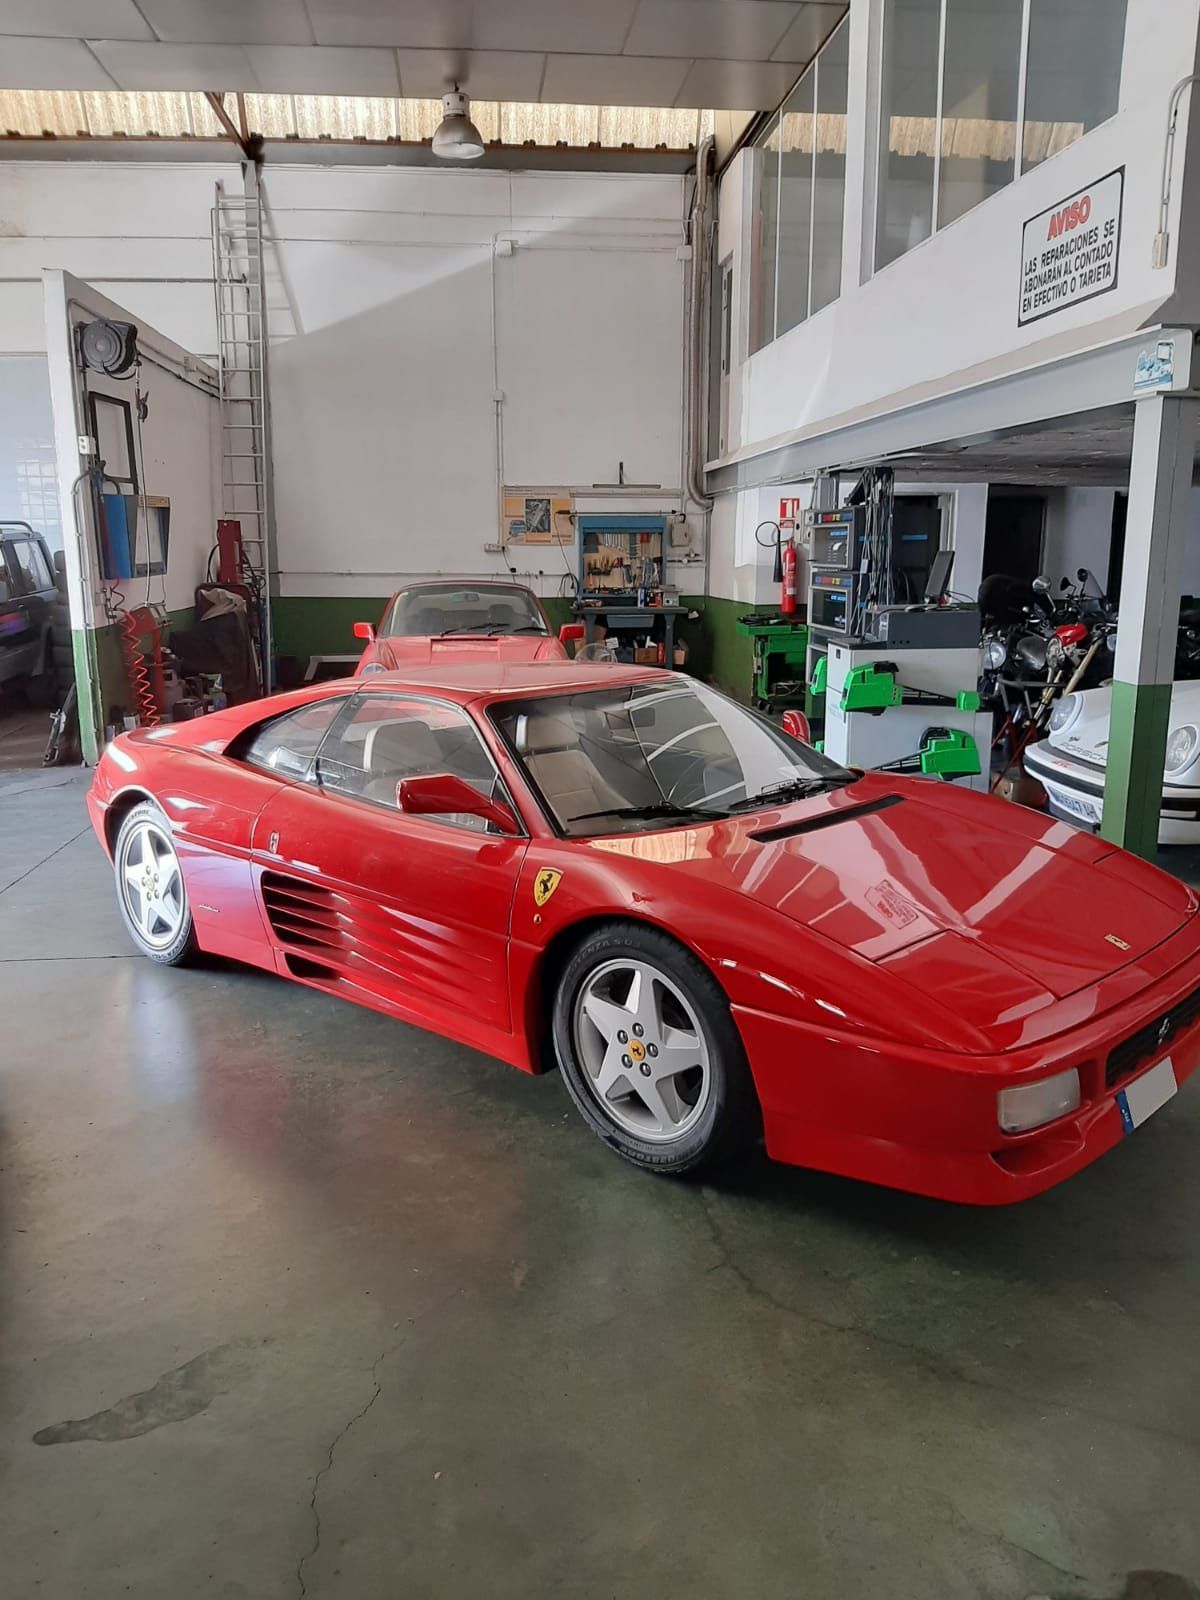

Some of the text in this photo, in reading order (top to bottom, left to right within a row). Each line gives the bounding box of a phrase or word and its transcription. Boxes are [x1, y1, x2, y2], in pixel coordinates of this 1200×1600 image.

[1047, 195, 1091, 241] AVISO
[1025, 218, 1115, 276] LAS REPARACIONES SE
[1063, 260, 1072, 277] AL
[1074, 240, 1113, 272] CONTADO
[1022, 261, 1111, 313] EN EFECTIVO O TARJETA
